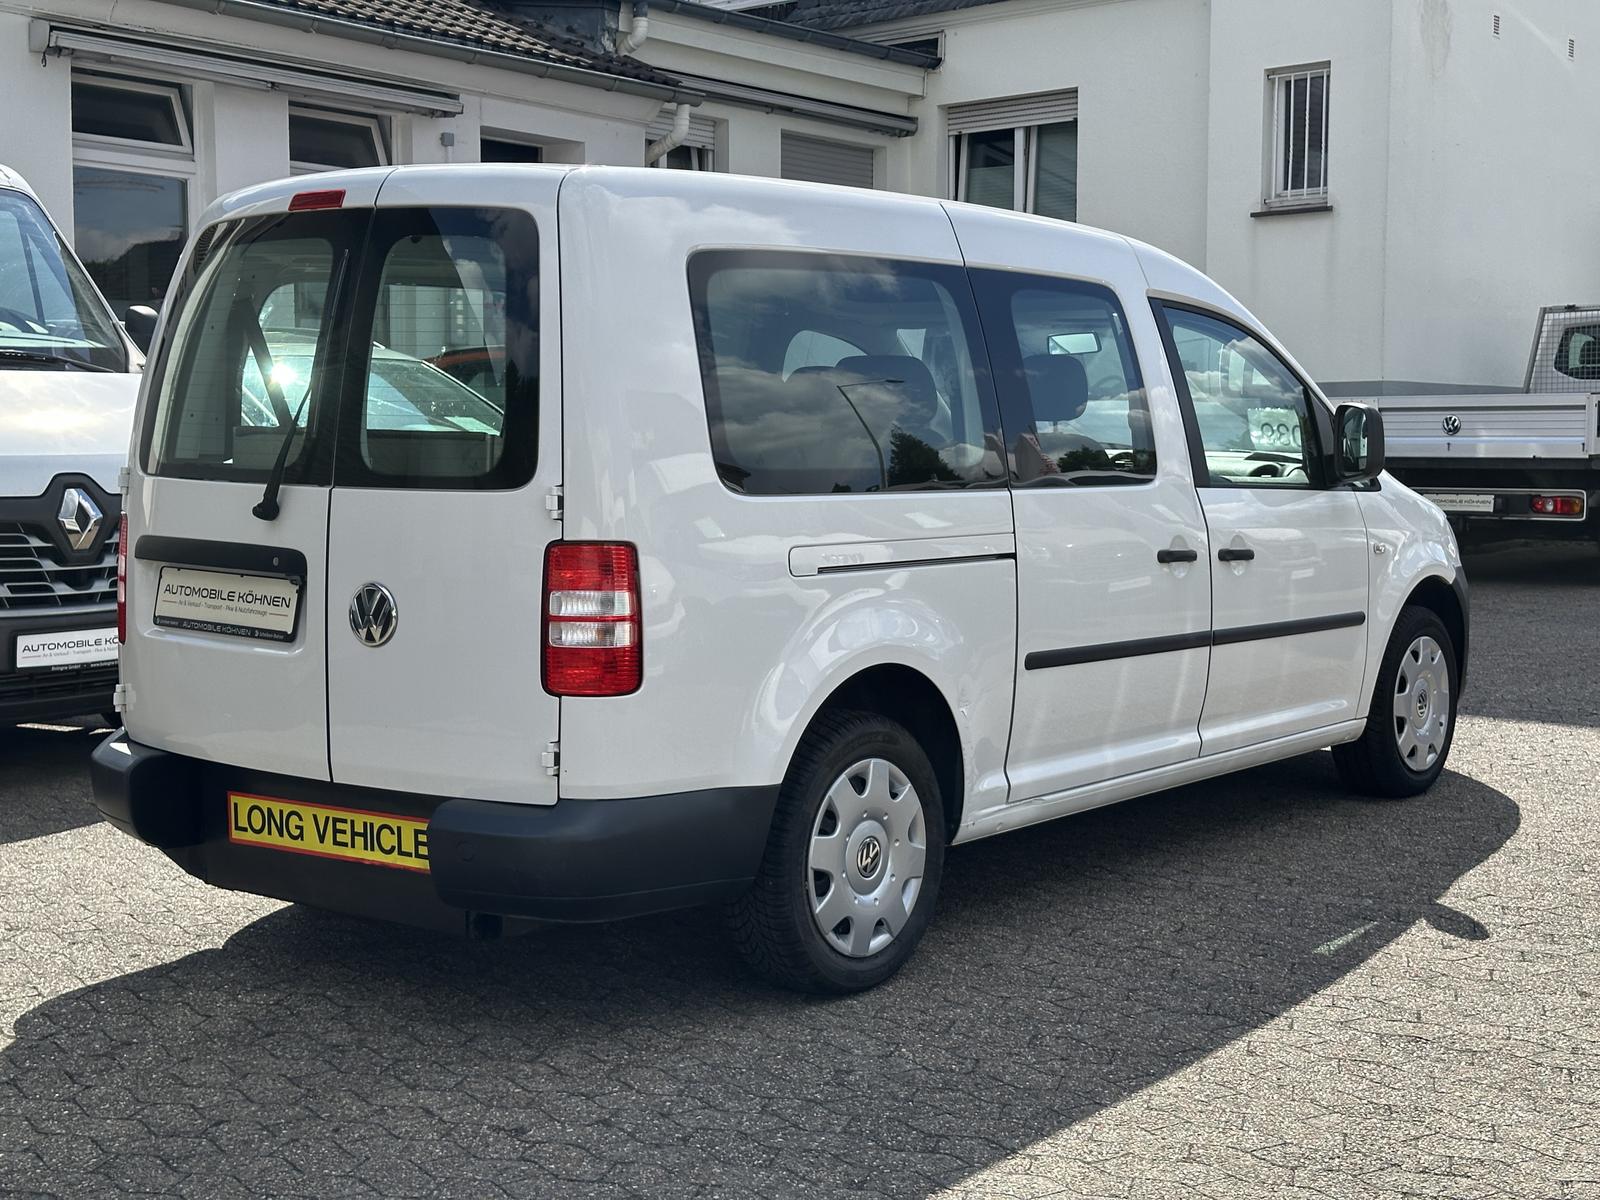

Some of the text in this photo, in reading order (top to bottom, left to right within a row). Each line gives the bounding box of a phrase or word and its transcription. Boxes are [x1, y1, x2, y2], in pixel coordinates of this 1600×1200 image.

[164, 584, 291, 608] AUTOMOBILE KÖHNEN
[349, 581, 398, 648] VW
[182, 621, 221, 632] AUTOMOBILE
[222, 623, 251, 636] KÖHNEN
[22, 638, 102, 653] AUTOMOBILE
[233, 802, 429, 860] LONG VEHICLE
